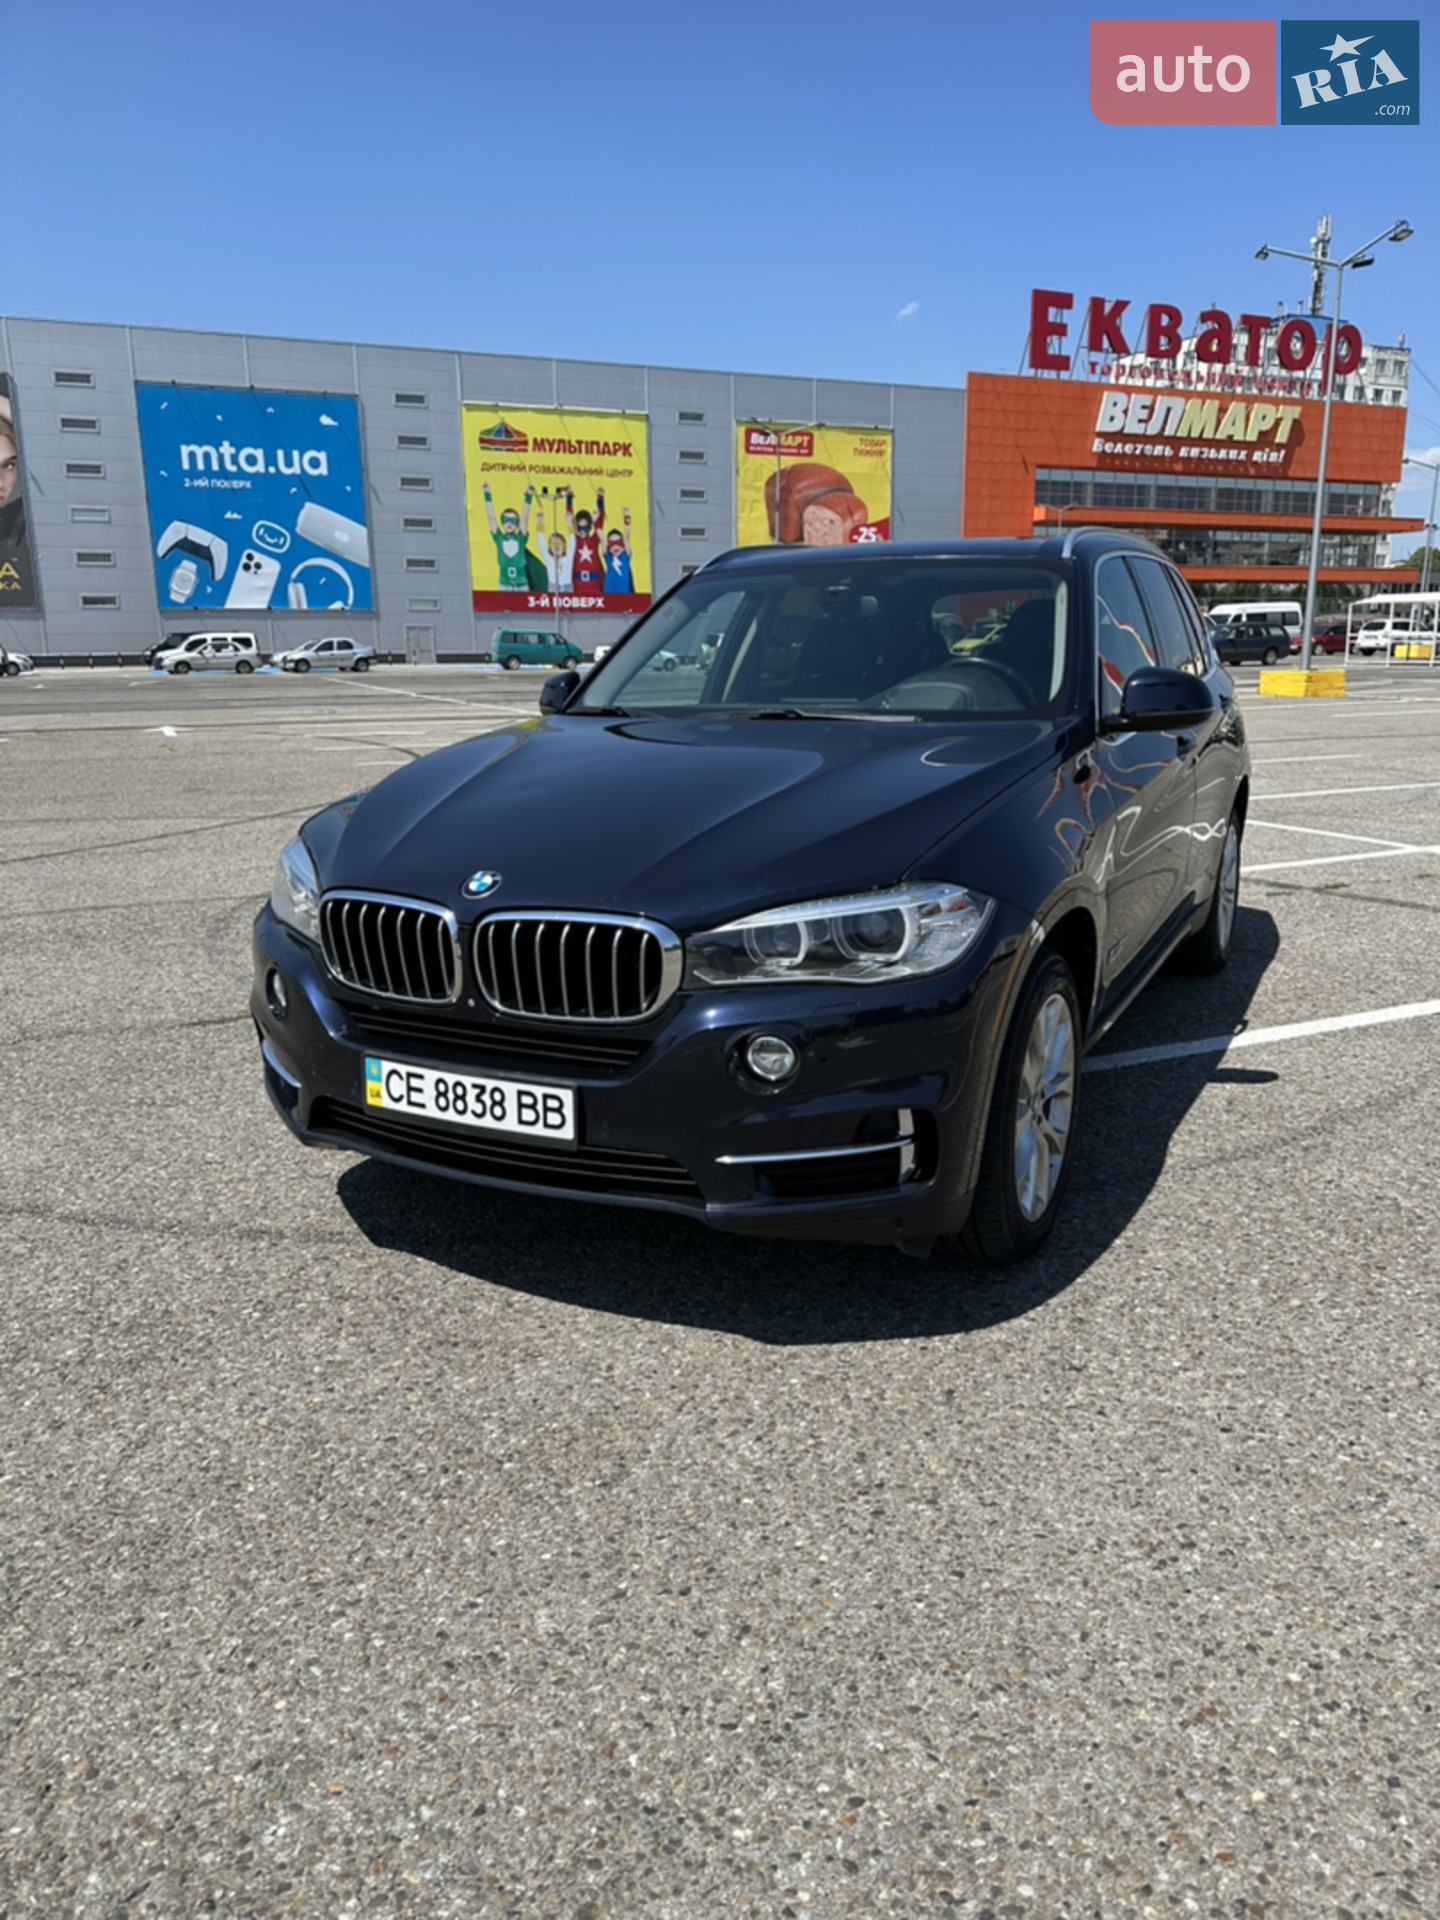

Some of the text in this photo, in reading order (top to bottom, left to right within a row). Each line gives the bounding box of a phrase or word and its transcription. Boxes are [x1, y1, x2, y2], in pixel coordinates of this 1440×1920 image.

[1096, 390, 1302, 444] ВЕЛМАРТ
[180, 439, 329, 477] mta.ua
[532, 436, 634, 458] МУЛЬТІПАРК
[480, 461, 634, 478] ДИТЯЧИЙ РОЗВАЖАЛЬНИЙ ЦЕНТР
[183, 477, 253, 490] 2-ИЙ ПОВЕРХ
[527, 593, 605, 609] 3-Й ПОВЕРХ
[384, 1067, 567, 1131] CE 8838 BB
